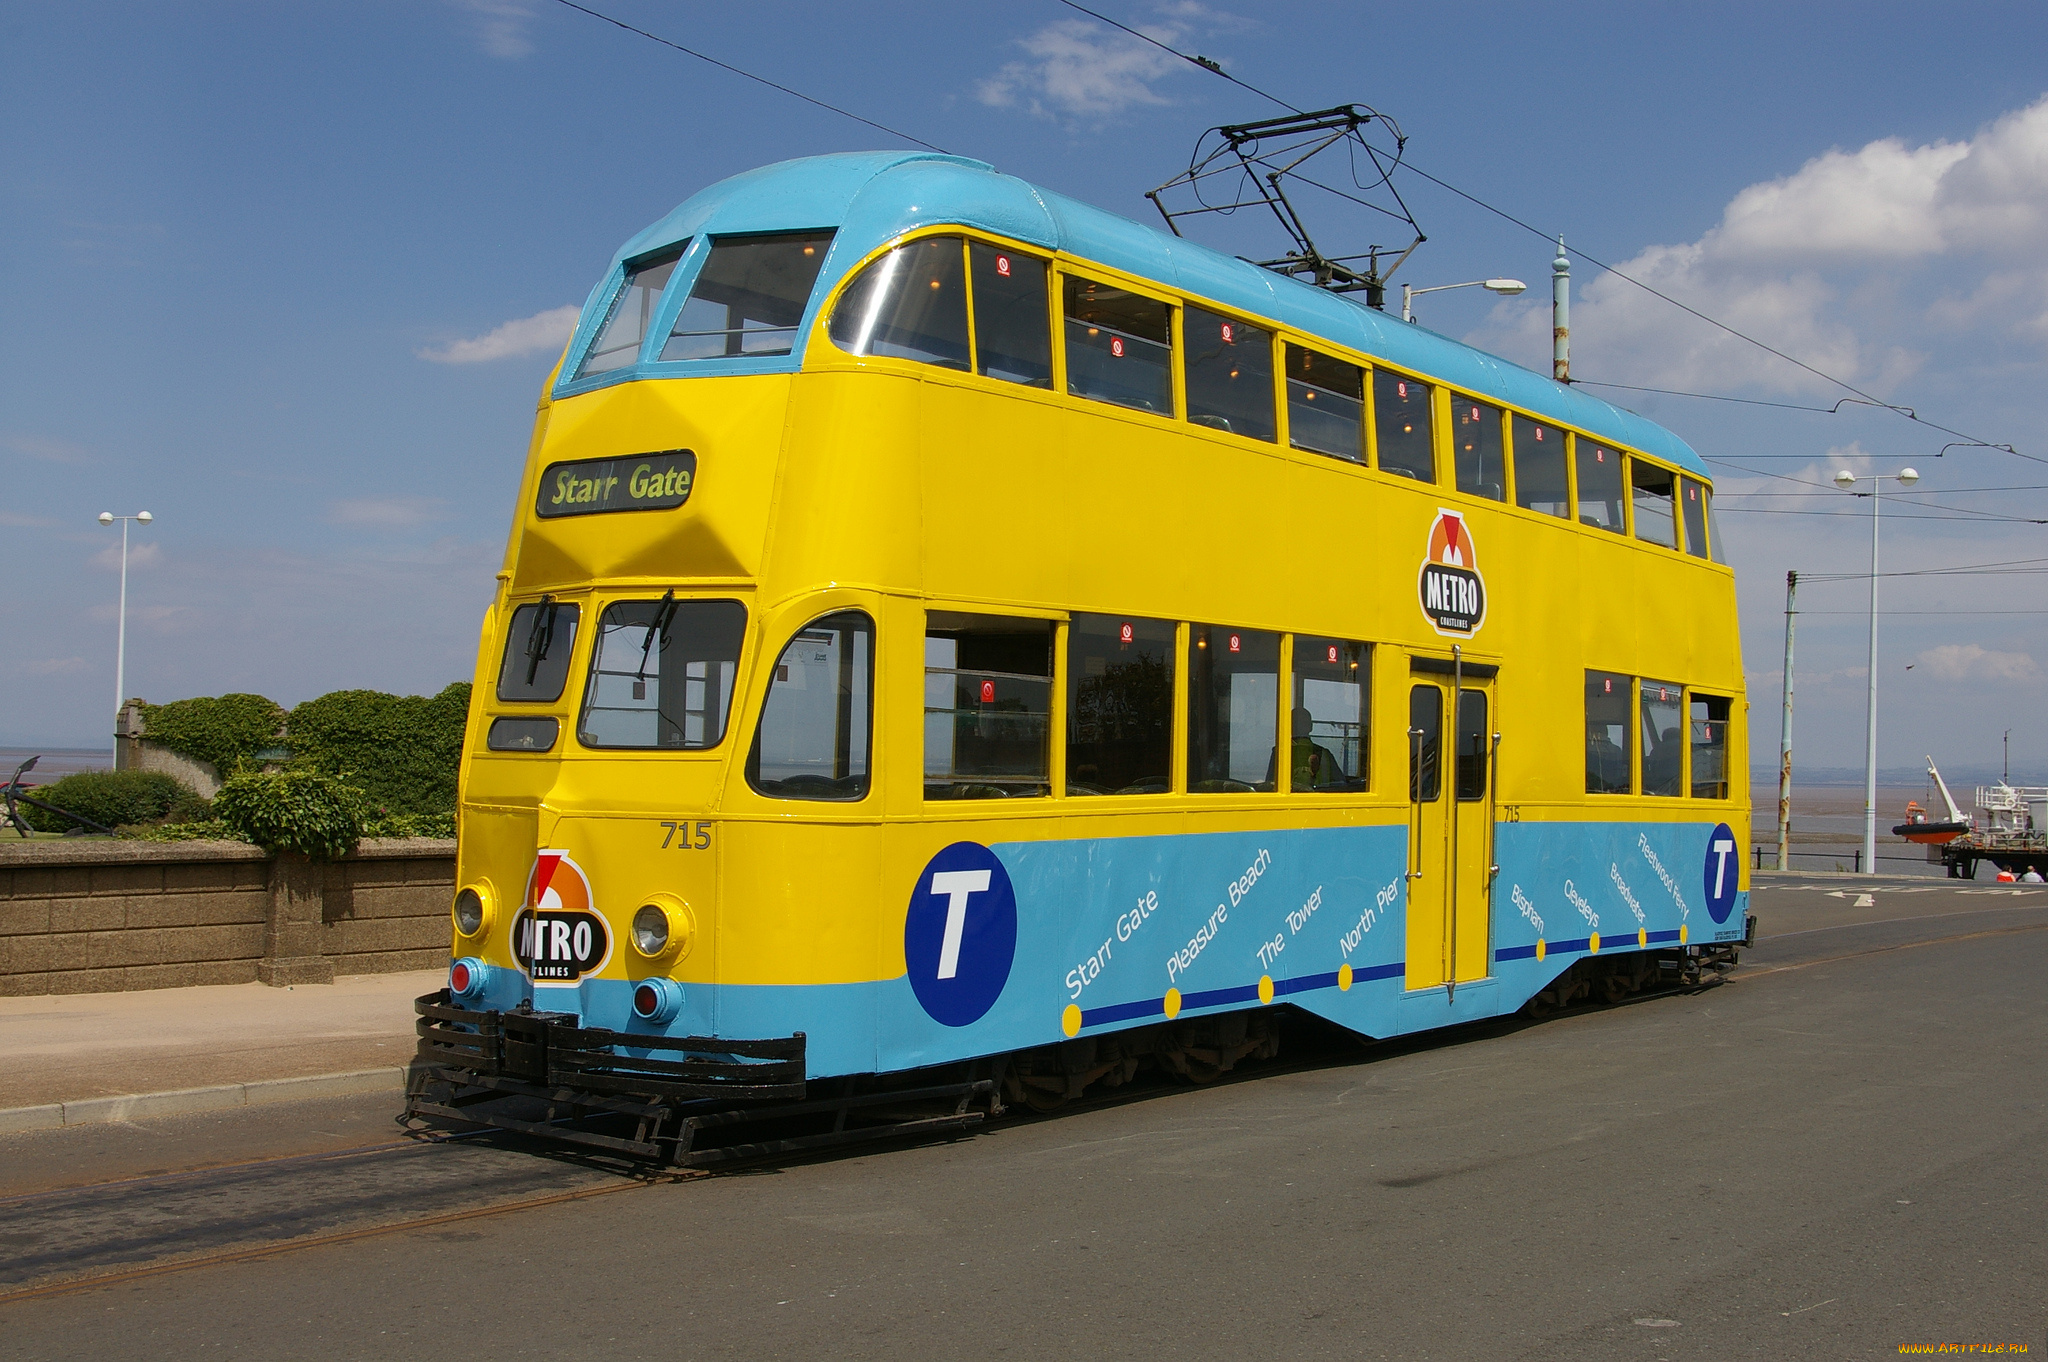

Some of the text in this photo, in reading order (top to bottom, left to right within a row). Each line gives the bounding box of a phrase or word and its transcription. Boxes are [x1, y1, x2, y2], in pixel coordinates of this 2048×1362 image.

[552, 463, 691, 505] Starr Gate
[1427, 571, 1478, 616] METRO
[660, 821, 712, 850] 715
[1504, 806, 1520, 823] 715
[1610, 862, 1646, 924] Broadwater
[1638, 832, 1690, 921] Fleetwood Ferry
[1713, 840, 1733, 899] T
[930, 869, 992, 980] T
[1166, 848, 1272, 984] Pleasure Beach
[1256, 885, 1324, 970] The Tower
[1339, 877, 1400, 959] North Pier
[1511, 883, 1545, 935] Bispham
[1564, 879, 1600, 928] Cleveleys
[520, 918, 592, 961] MTRO
[1065, 890, 1159, 999] Starr Gate
